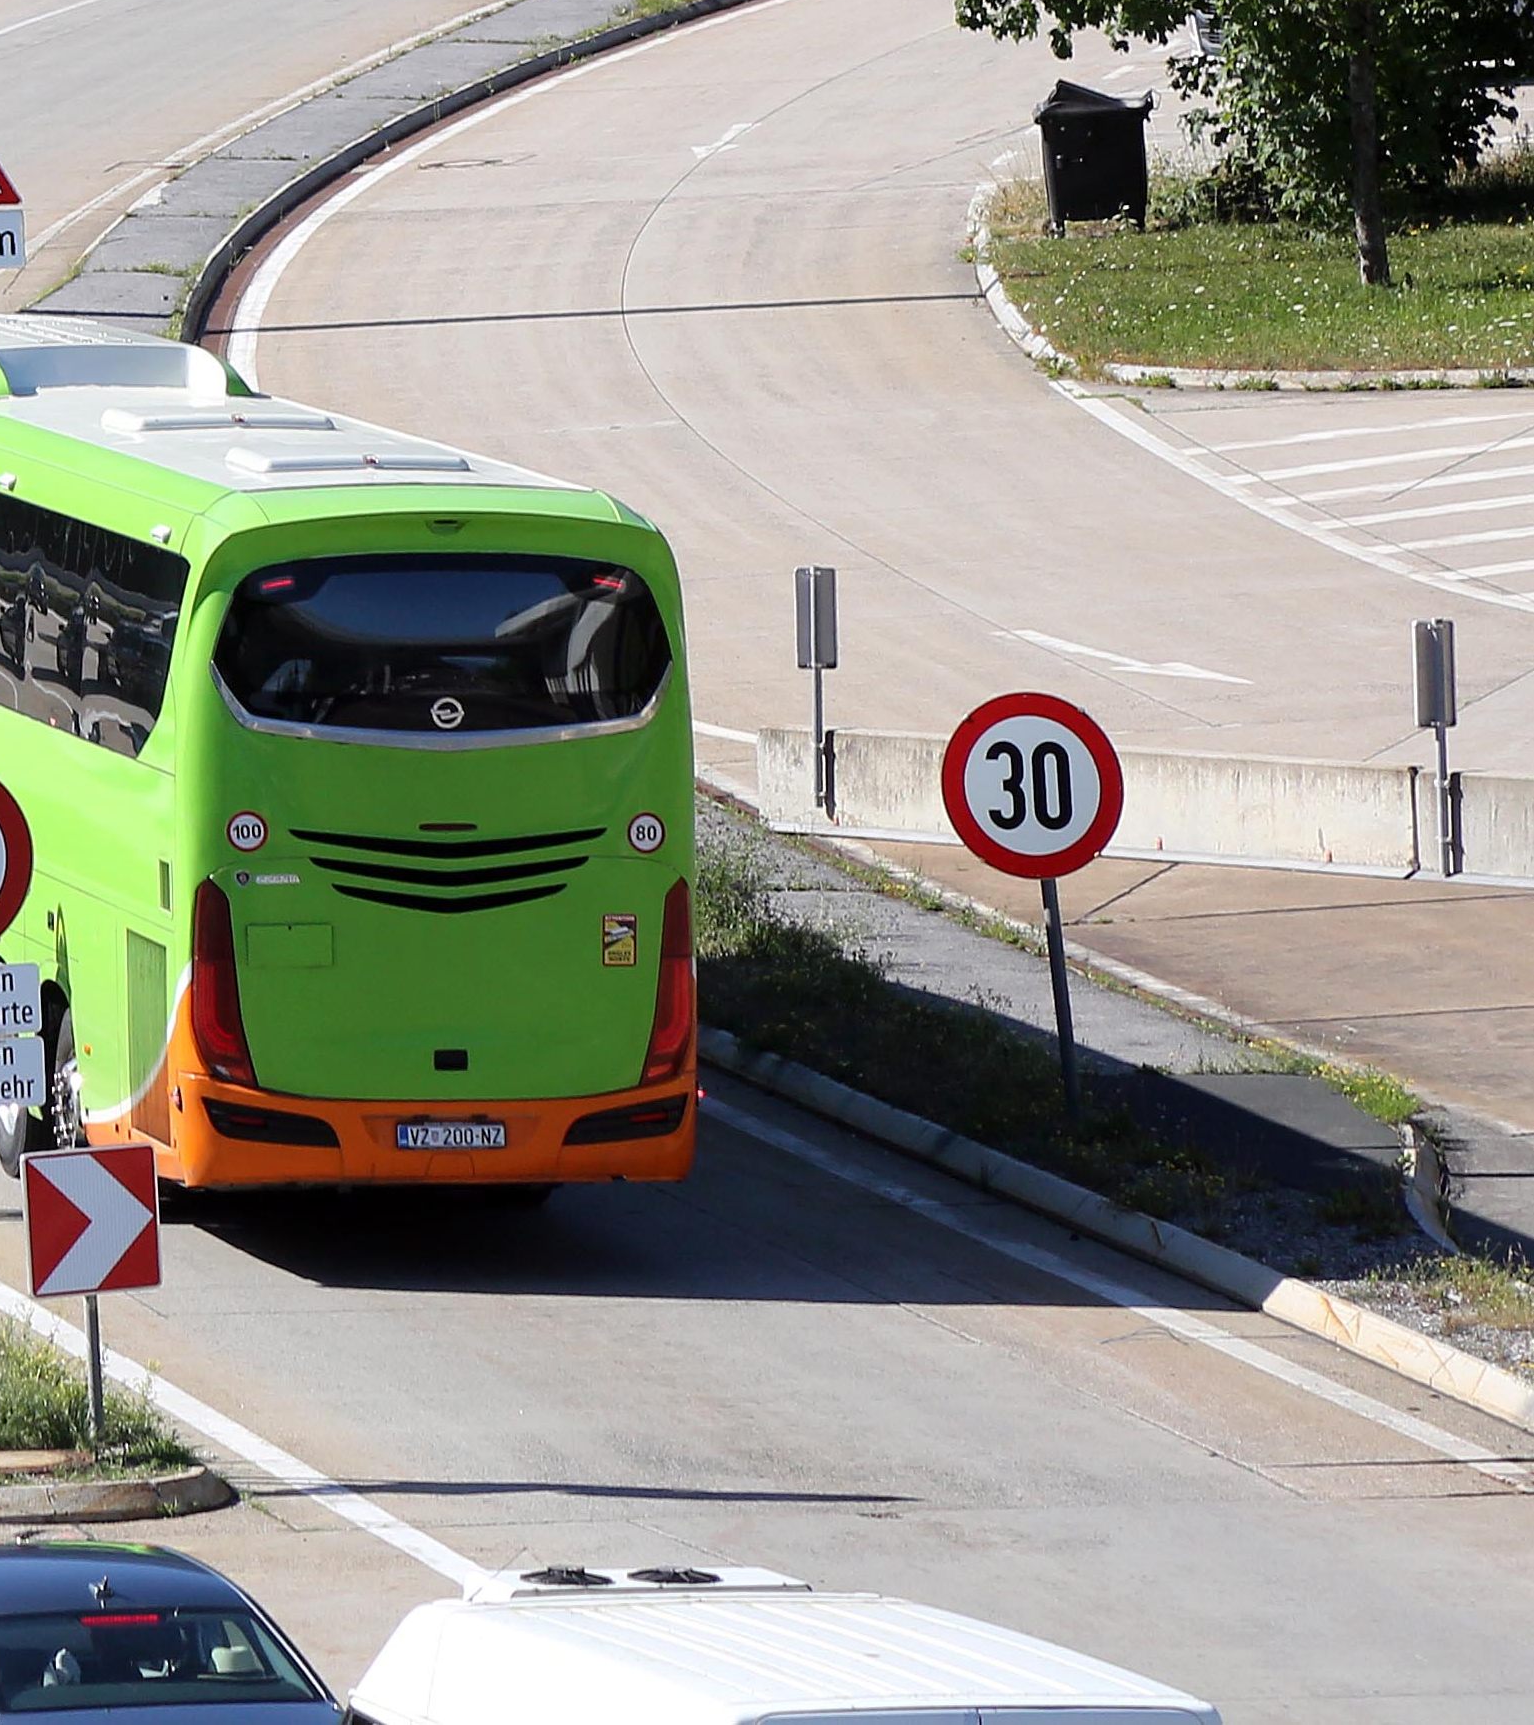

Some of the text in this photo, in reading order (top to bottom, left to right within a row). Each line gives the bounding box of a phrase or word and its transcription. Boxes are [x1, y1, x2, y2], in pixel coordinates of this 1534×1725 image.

[985, 741, 1073, 830] 30
[233, 823, 262, 841] 100
[636, 825, 657, 841] 80
[409, 1127, 502, 1145] VZ 200-NZ
